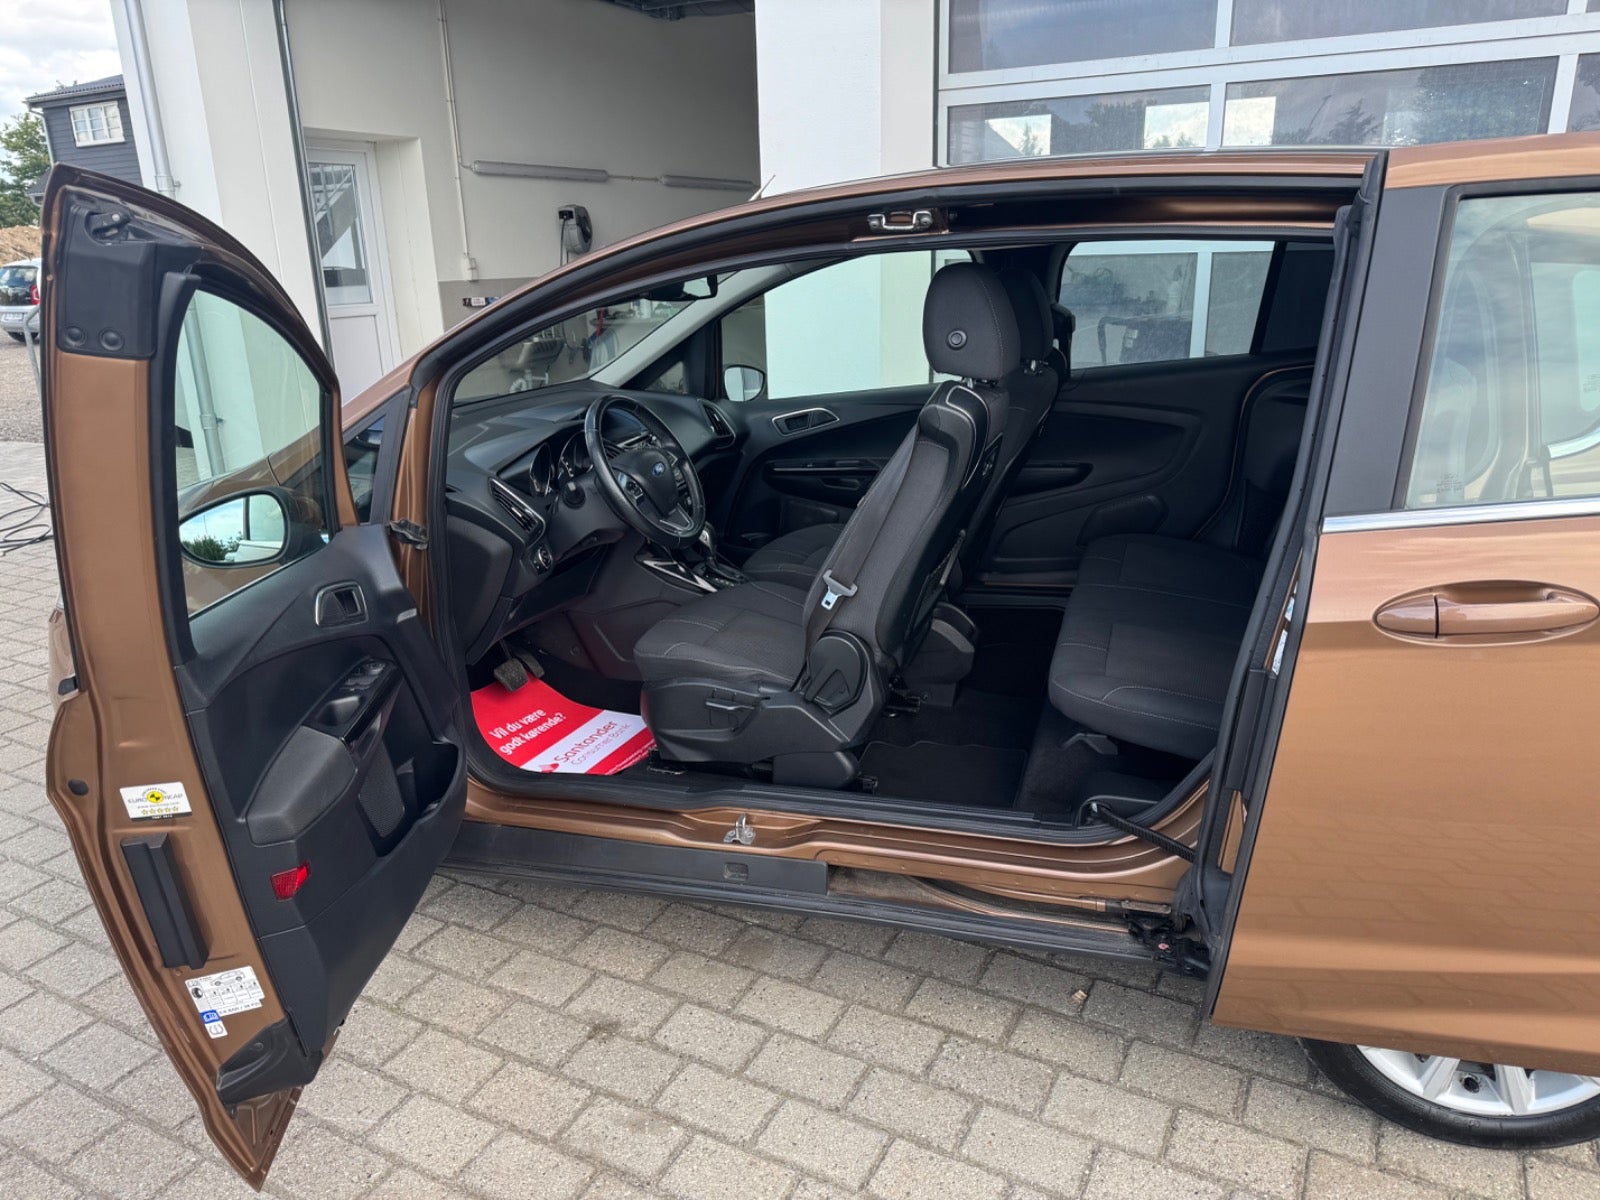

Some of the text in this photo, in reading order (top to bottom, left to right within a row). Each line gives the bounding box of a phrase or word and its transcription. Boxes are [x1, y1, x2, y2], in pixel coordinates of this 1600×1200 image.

[489, 709, 546, 739] Vil du være
[499, 736, 526, 755] godt
[554, 721, 618, 763] Santander
